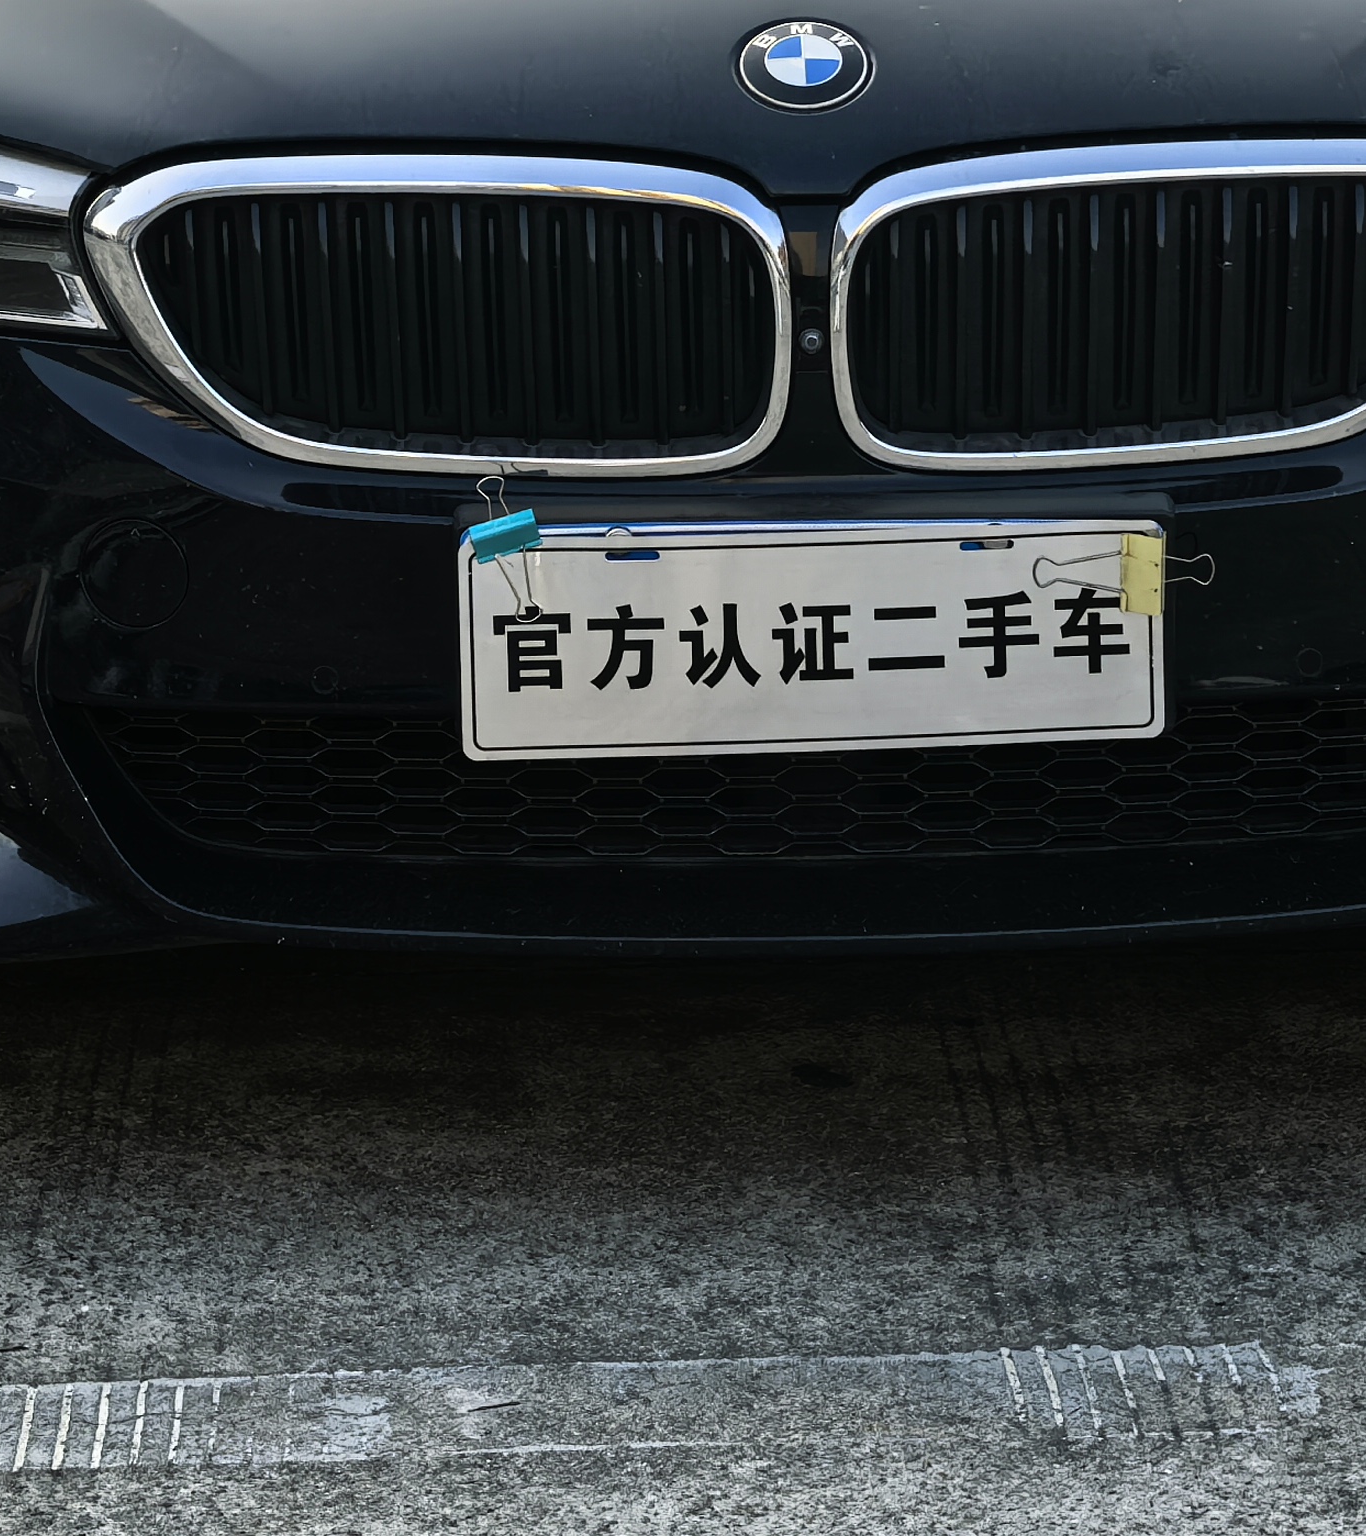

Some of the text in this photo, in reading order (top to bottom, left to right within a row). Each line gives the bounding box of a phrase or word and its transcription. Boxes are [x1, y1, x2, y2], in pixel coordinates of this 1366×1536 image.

[752, 24, 854, 49] BMW
[493, 588, 1130, 692] 官方认证二手车
